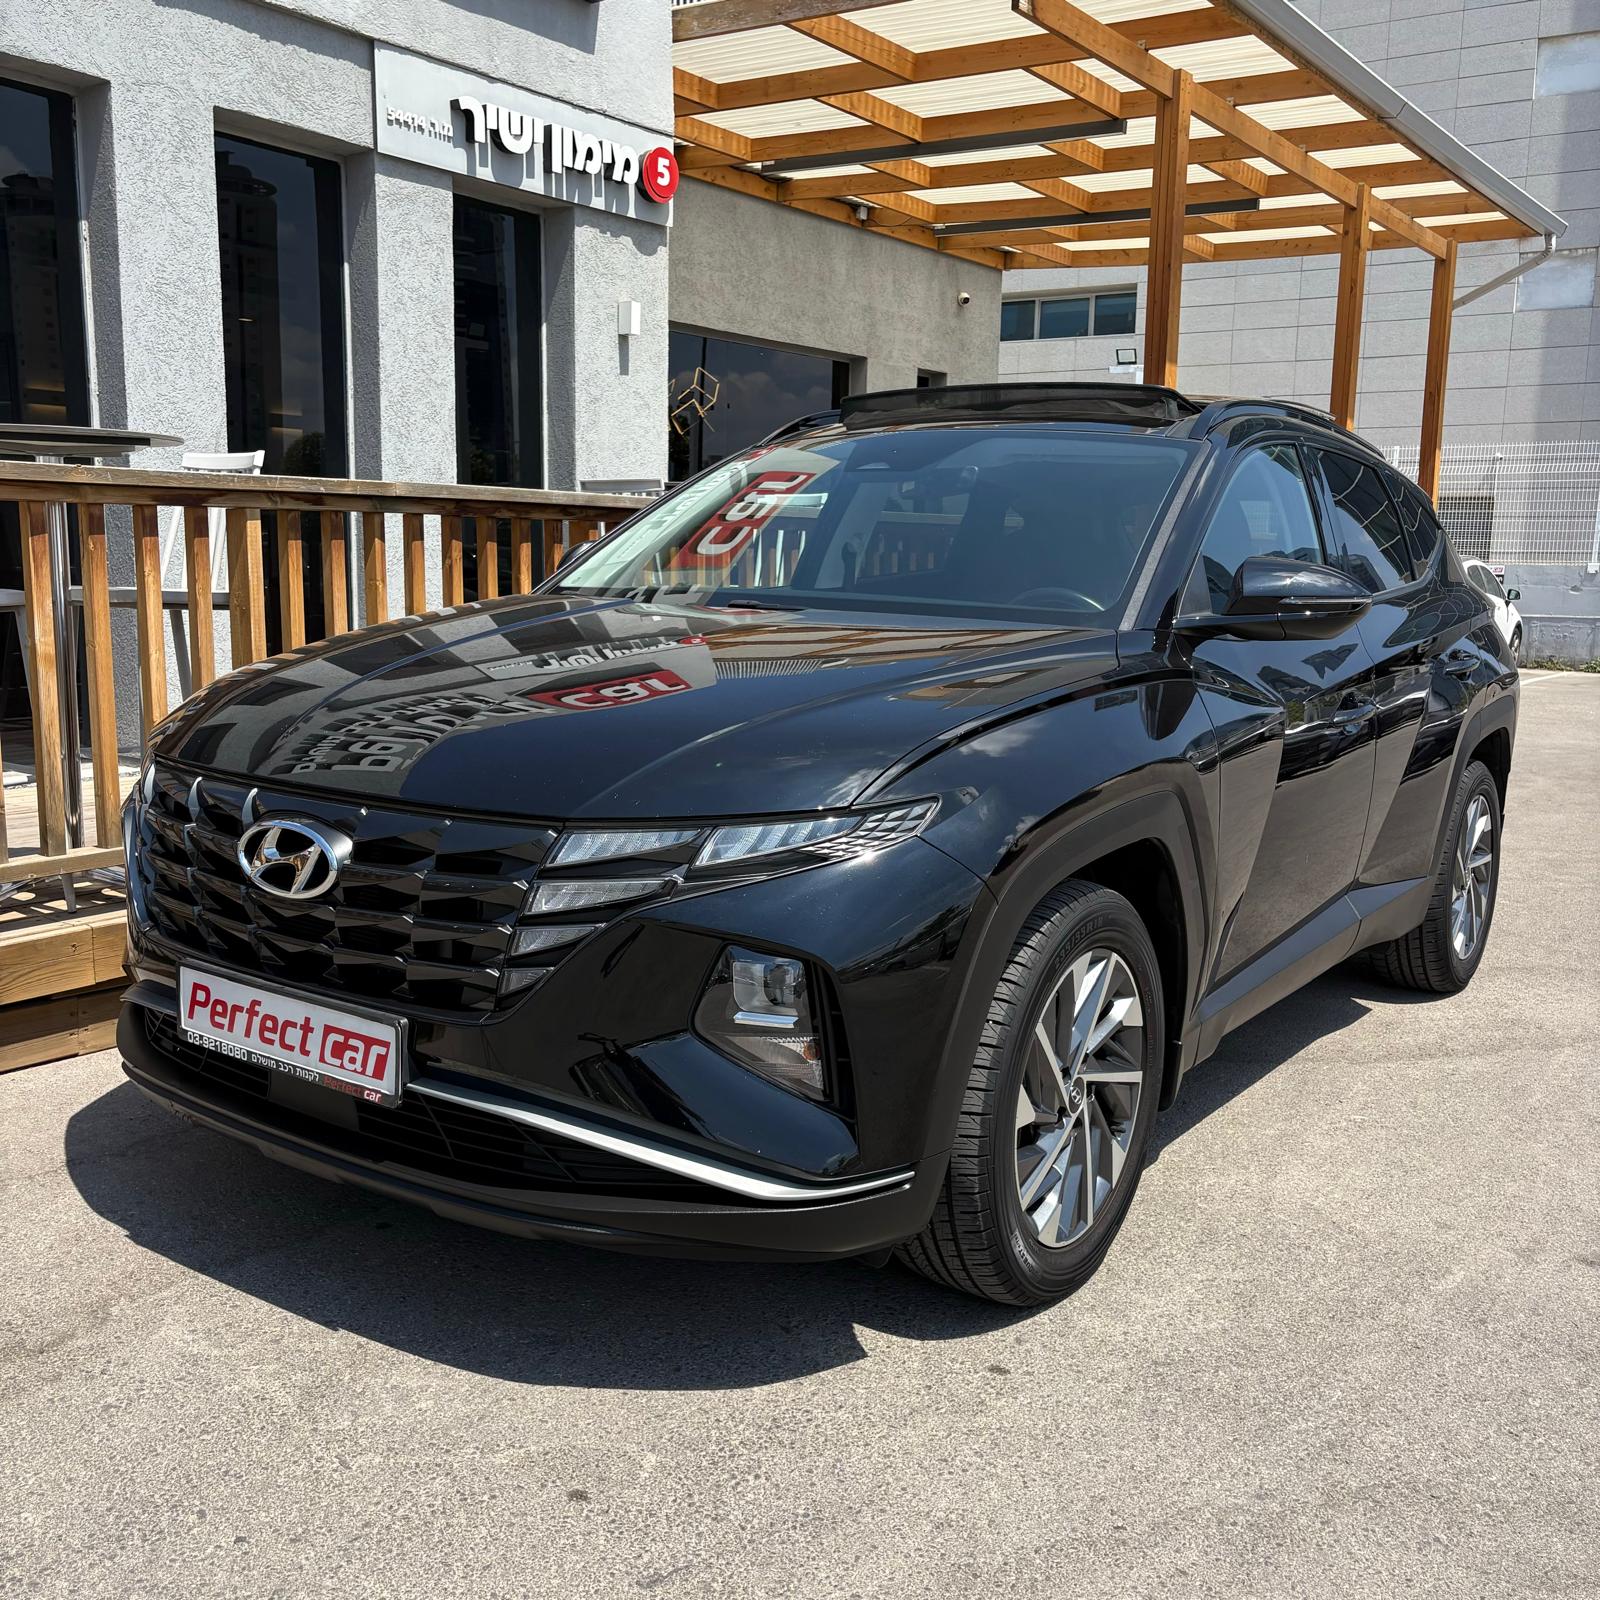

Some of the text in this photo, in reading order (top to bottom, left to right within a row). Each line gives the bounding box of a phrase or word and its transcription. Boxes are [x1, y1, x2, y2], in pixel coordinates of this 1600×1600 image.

[387, 107, 426, 129] 54414
[457, 95, 671, 186] 5 מימון ישיר
[187, 981, 388, 1077] Perfect car
[187, 1031, 248, 1061] 03-9218080
[251, 1053, 319, 1082] לקנות רכב מושלם
[363, 1089, 382, 1103] car
